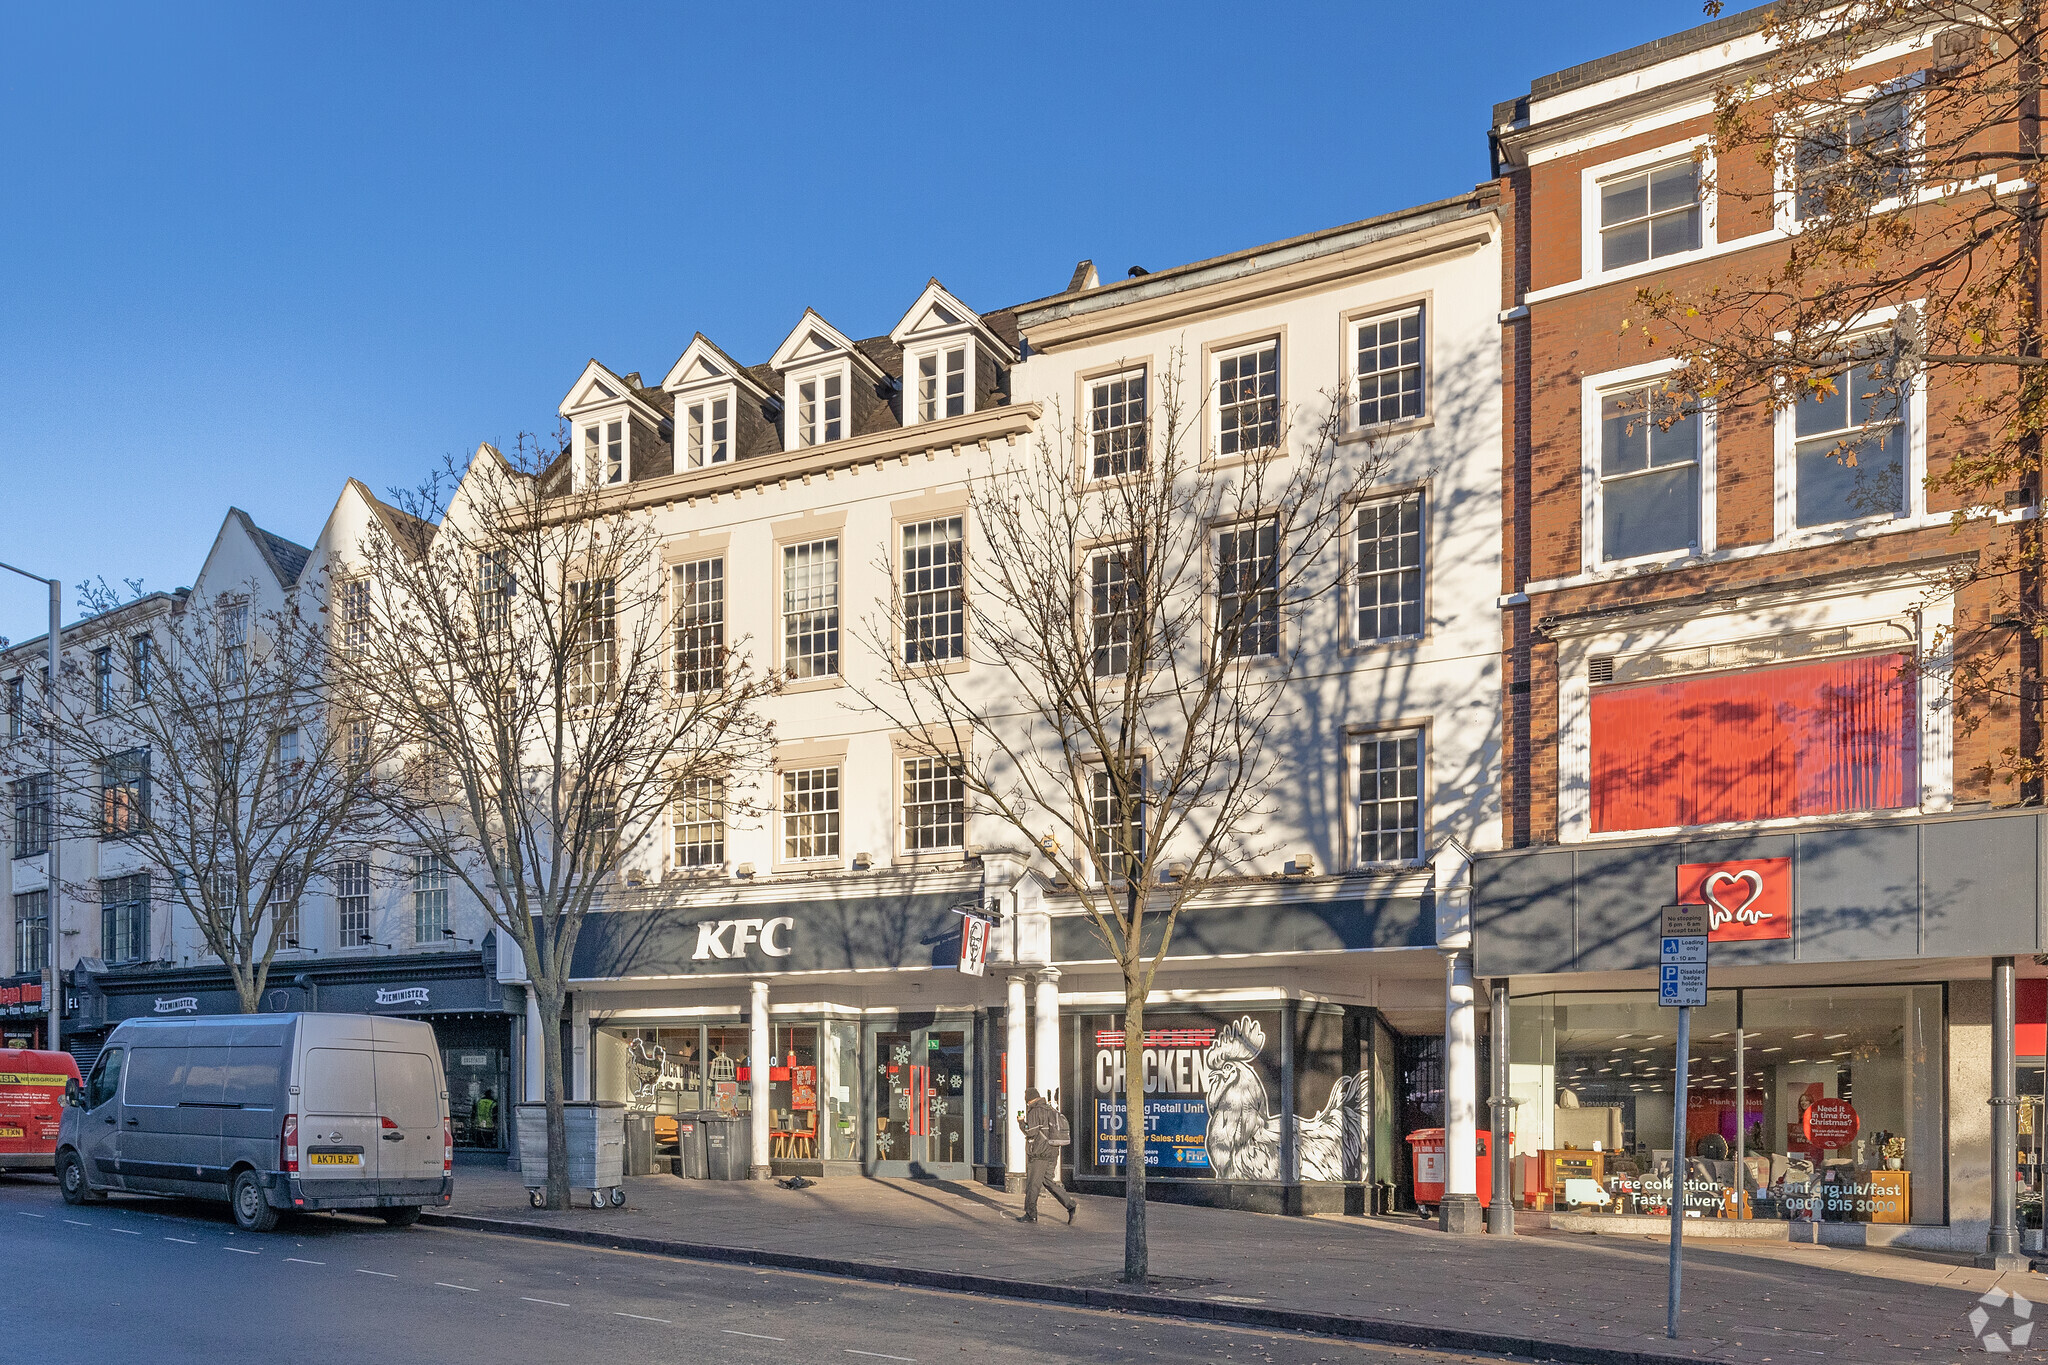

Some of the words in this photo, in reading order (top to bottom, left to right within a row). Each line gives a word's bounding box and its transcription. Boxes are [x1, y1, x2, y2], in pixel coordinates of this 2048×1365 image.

[692, 917, 794, 959] KFC
[382, 990, 424, 1002] PIEMINISTER
[160, 1000, 193, 1010] PIEMINISTER
[1096, 1049, 1211, 1093] CHCKEN
[1100, 1103, 1151, 1114] Remag
[1153, 1104, 1180, 1113] Retail
[1184, 1104, 1204, 1113] Unit
[1100, 1115, 1123, 1130] TO
[1175, 1135, 1204, 1144] 814sqft
[317, 1155, 336, 1164] AK71
[338, 1155, 354, 1164] BJZ
[1100, 1155, 1124, 1163] 07817
[1186, 1151, 1206, 1160] FHP
[1611, 1177, 1641, 1189] Free
[1784, 1182, 1901, 1198] bhf.org.uk/fast
[1631, 1193, 1664, 1205] Fast
[1786, 1198, 1824, 1210] 0800
[1828, 1199, 1852, 1211] 915
[1856, 1201, 1896, 1212] 3000
